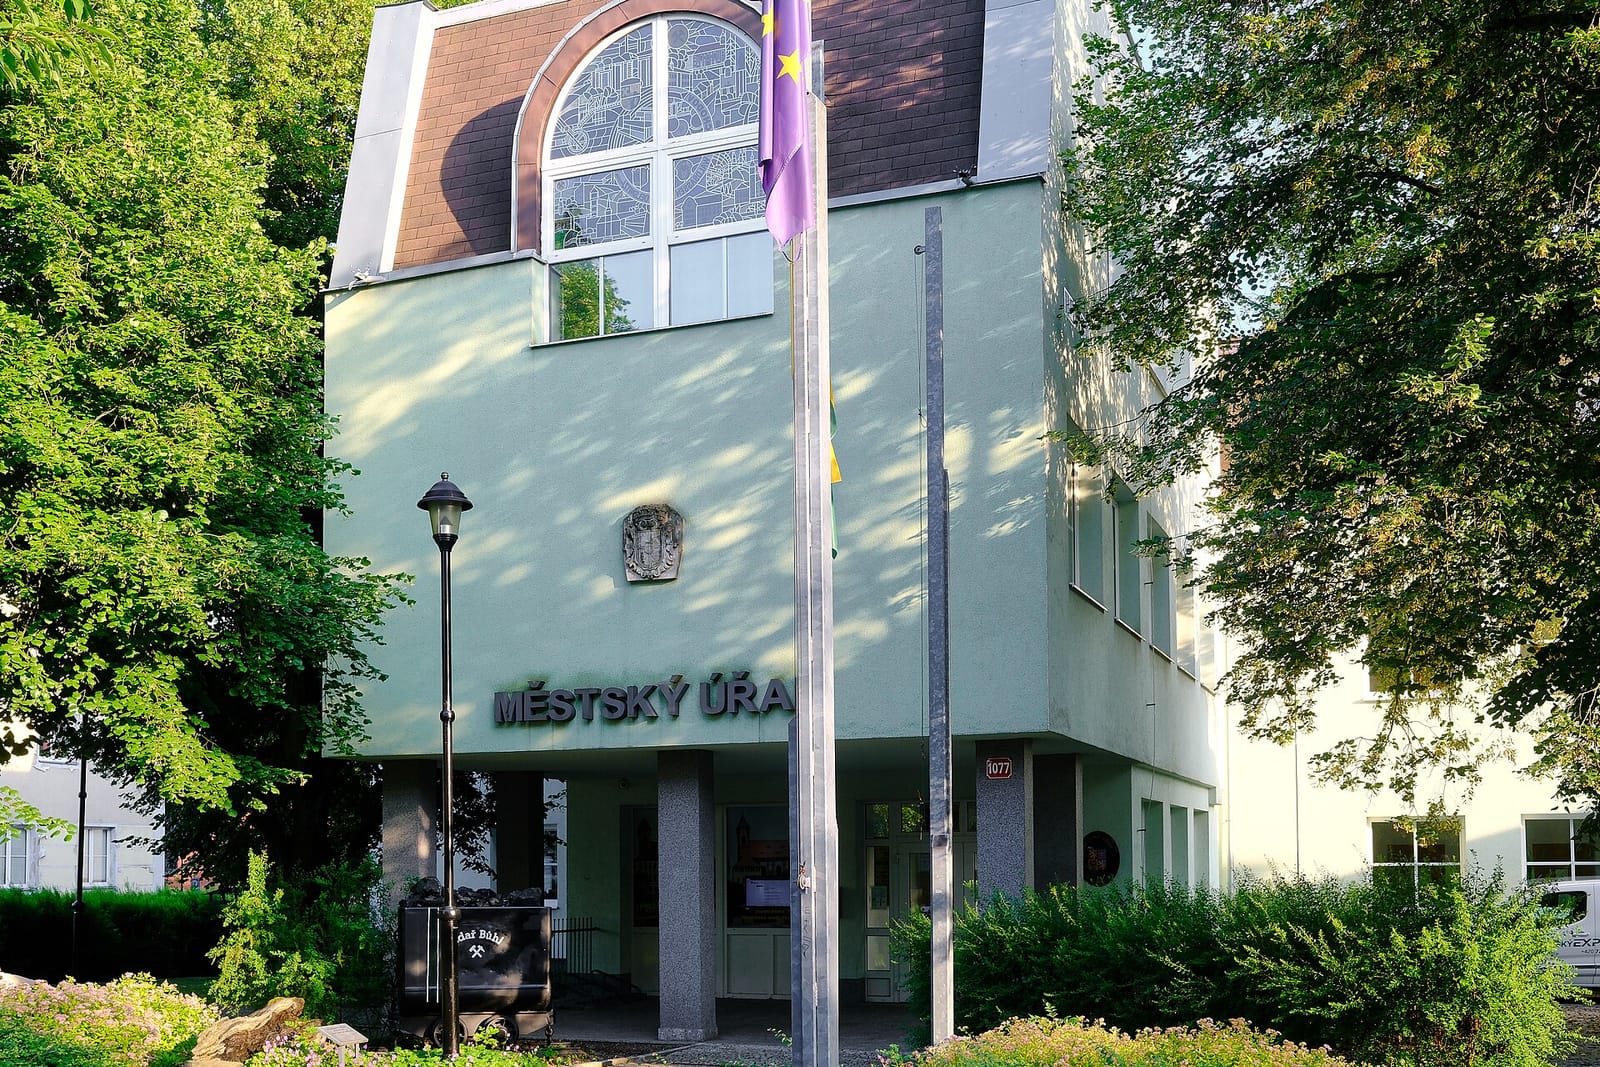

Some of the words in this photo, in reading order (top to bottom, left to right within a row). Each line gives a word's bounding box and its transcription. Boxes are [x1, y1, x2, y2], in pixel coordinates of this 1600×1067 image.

[494, 674, 691, 723] MĚSTSKÝ
[700, 671, 797, 715] ÚŘA
[988, 762, 1010, 775] 1077
[457, 929, 476, 943] dař
